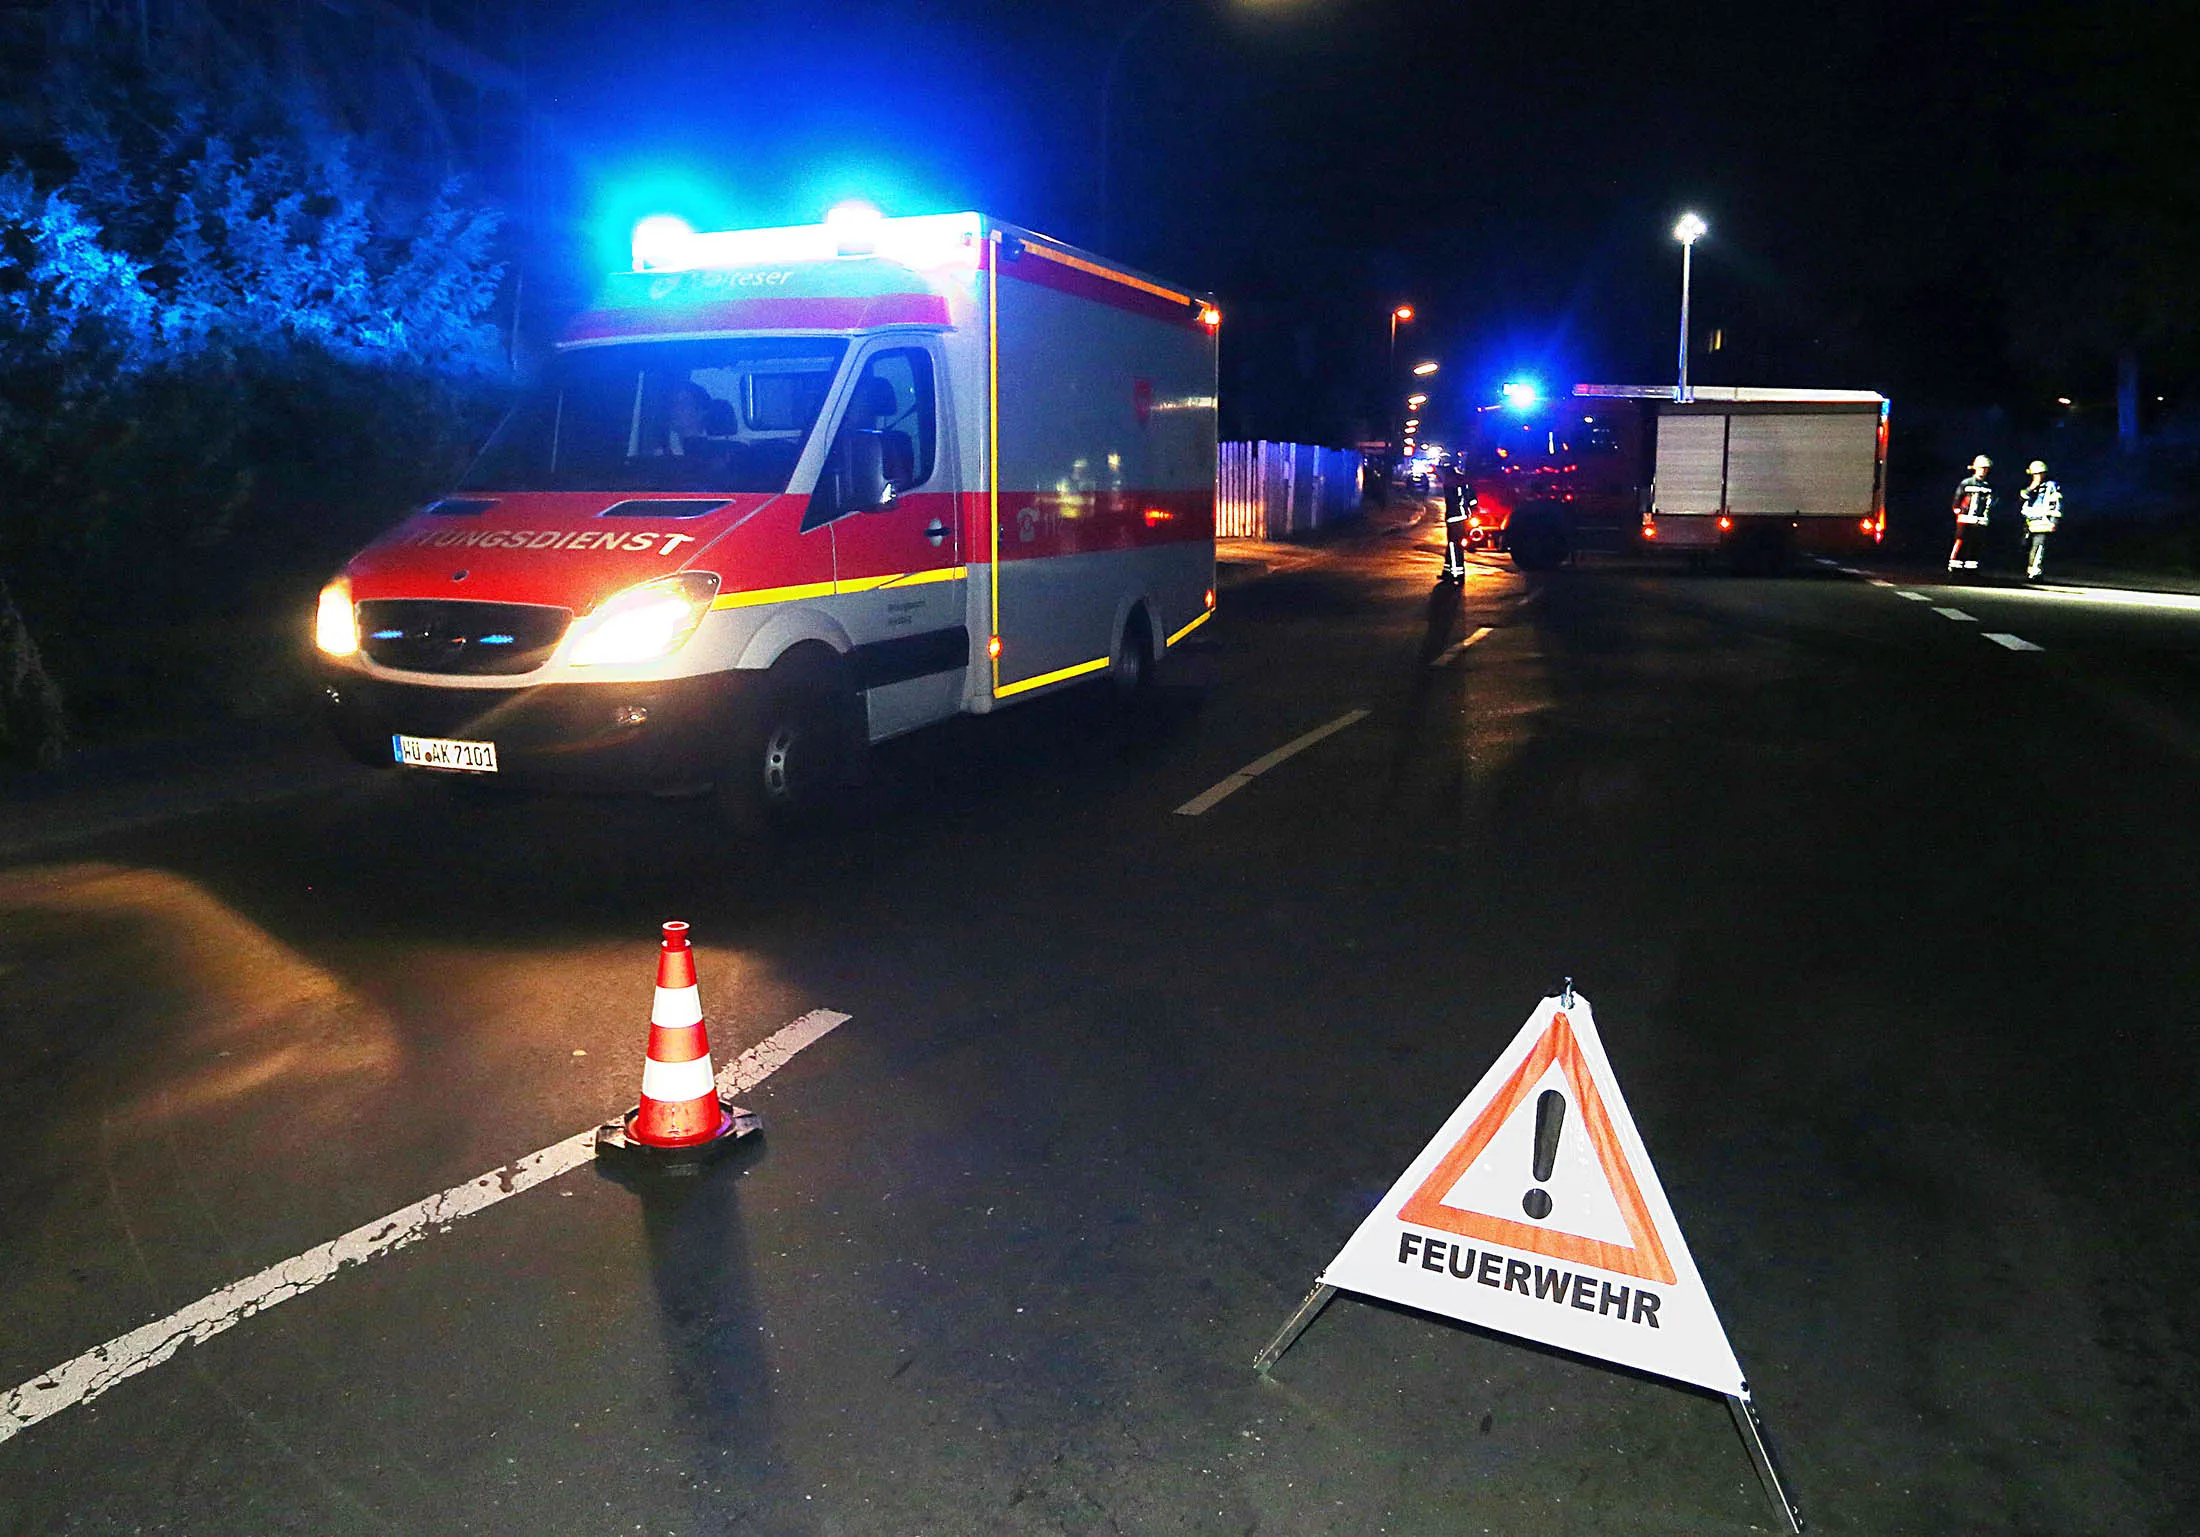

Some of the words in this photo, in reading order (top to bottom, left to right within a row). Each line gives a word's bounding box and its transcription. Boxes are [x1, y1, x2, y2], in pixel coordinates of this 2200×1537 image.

[432, 743, 451, 764] AK
[454, 745, 494, 767] 7101
[1398, 1232, 1661, 1328] FEUERWEHR
